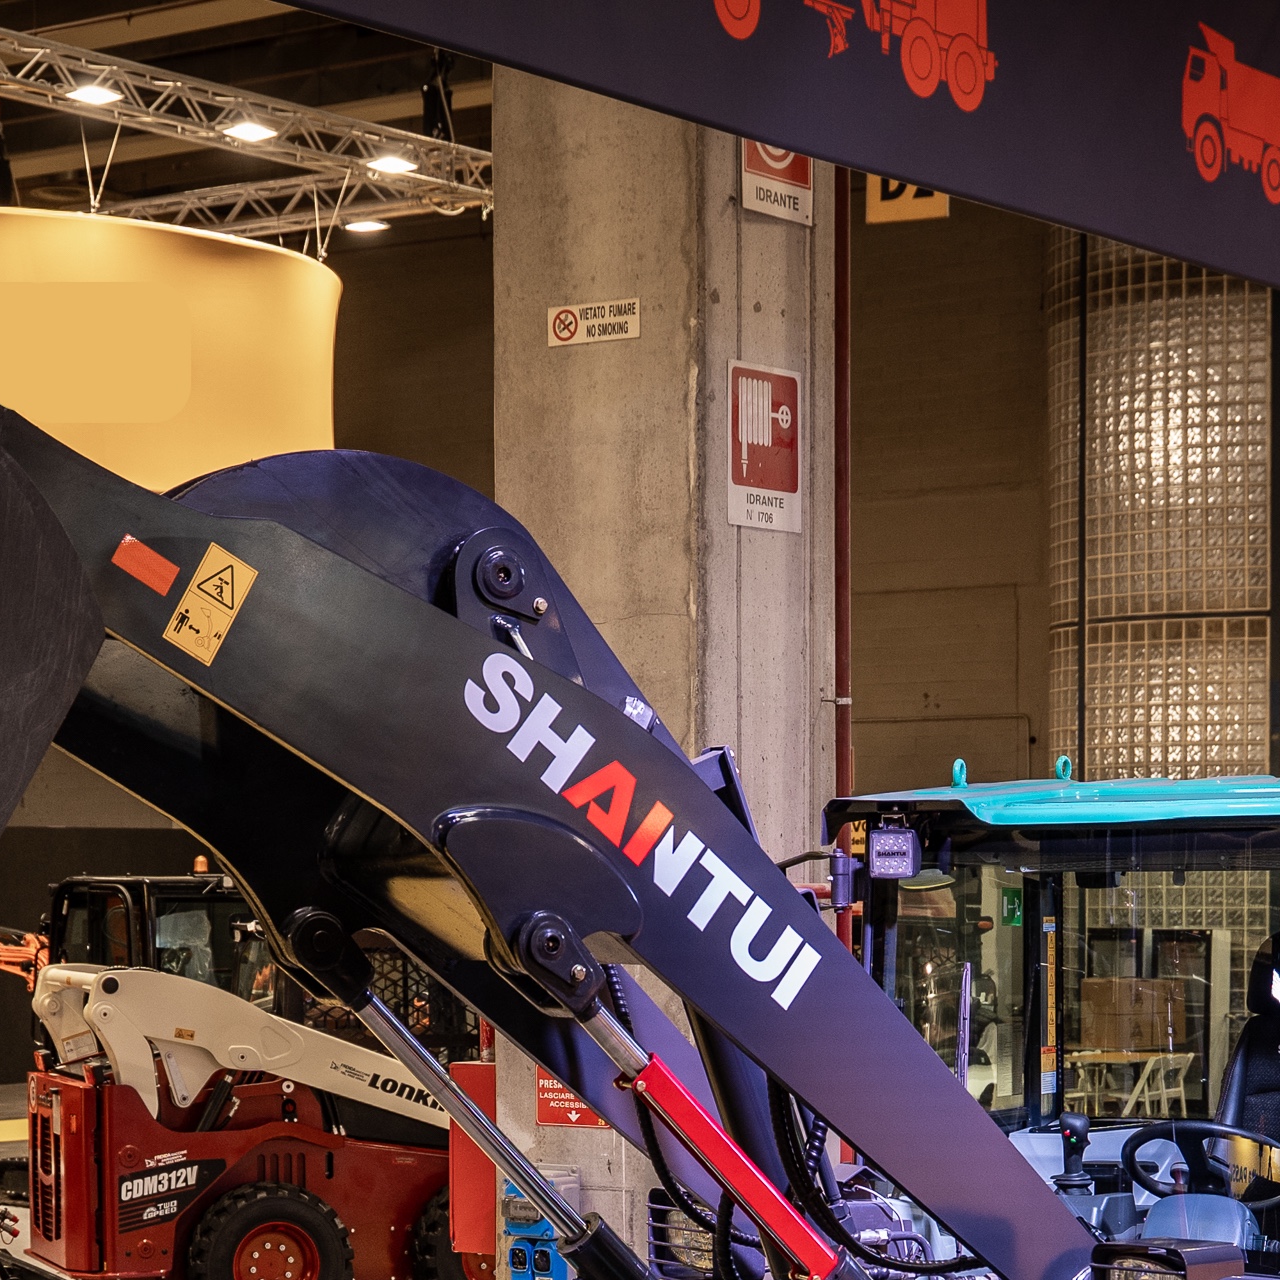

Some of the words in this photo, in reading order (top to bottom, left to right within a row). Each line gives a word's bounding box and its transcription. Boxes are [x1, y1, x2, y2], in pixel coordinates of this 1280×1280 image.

[755, 185, 800, 212] IDRANTE
[579, 305, 606, 321] VIETATO
[608, 302, 636, 318] FUMARE
[586, 325, 596, 338] NO
[597, 321, 629, 336] SMOKING
[746, 493, 784, 509] IDRANTE
[463, 652, 822, 1011] SHANTUI
[539, 1092, 575, 1100] LASCIARE
[549, 1101, 589, 1109] ACCESSIB
[120, 1165, 199, 1201] CDM312V
[157, 1199, 177, 1210] TWO
